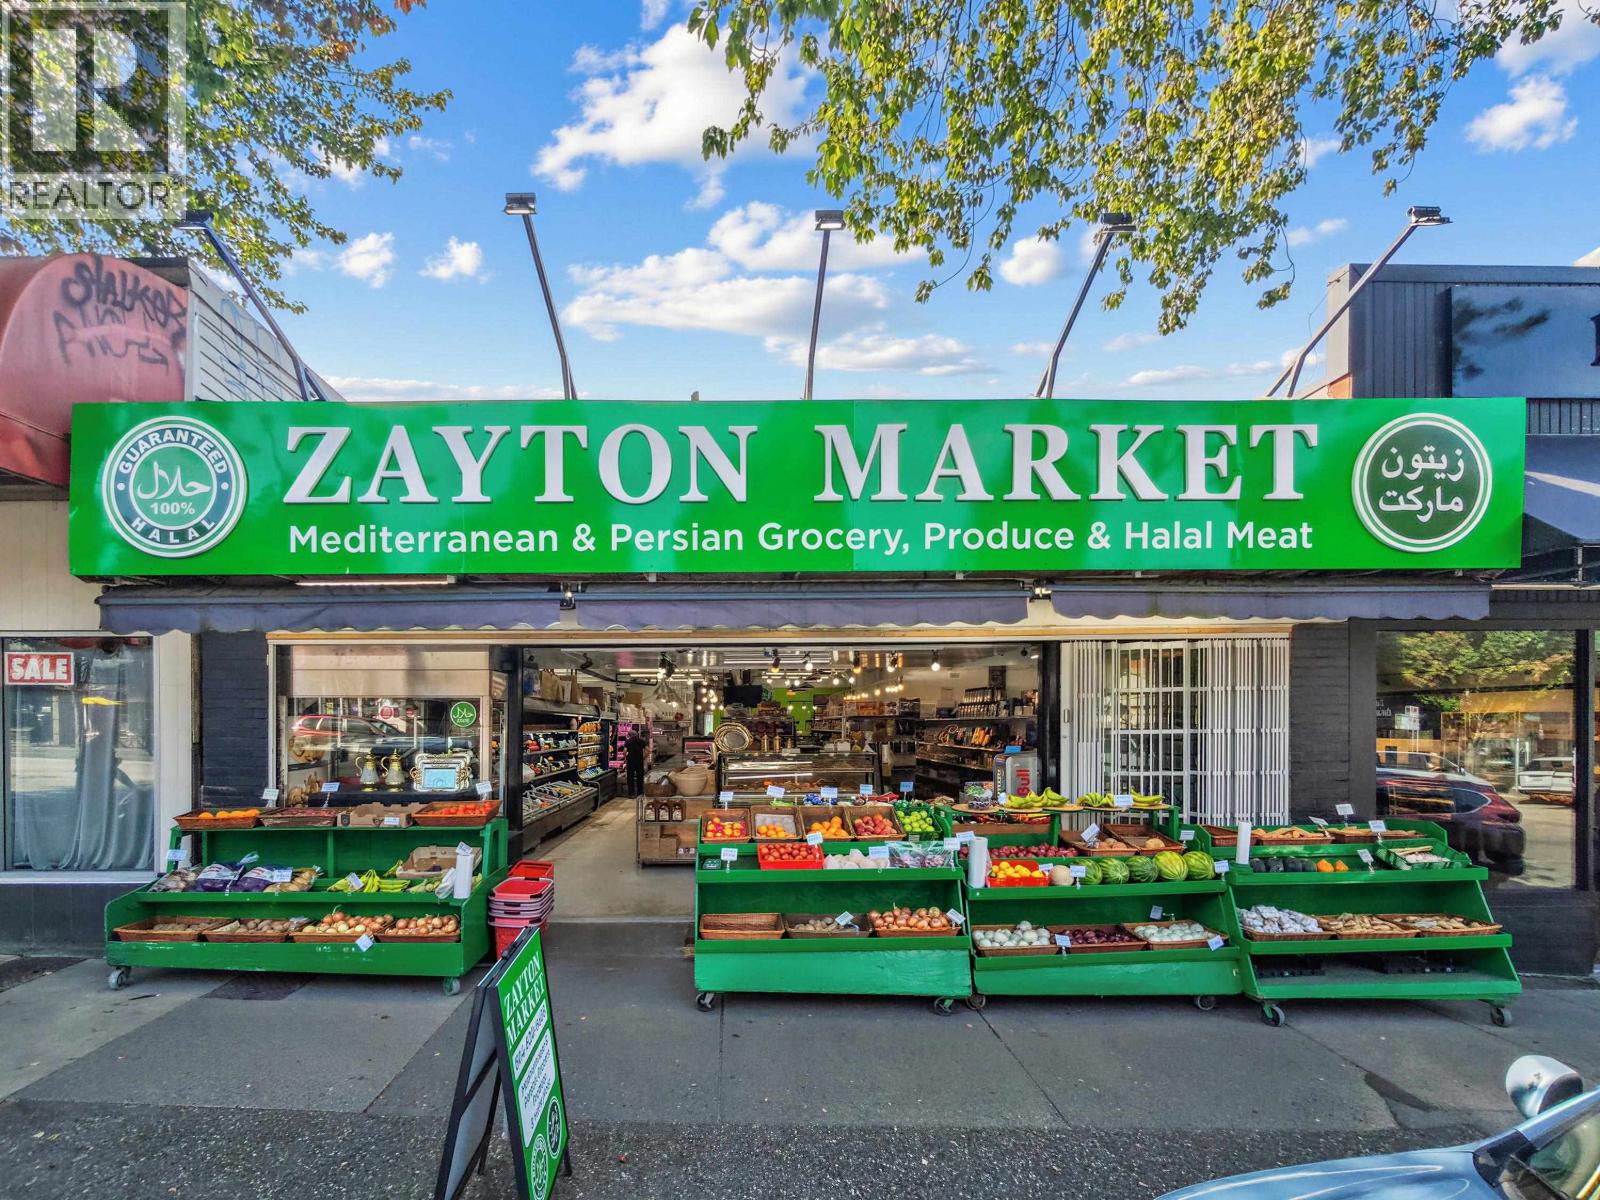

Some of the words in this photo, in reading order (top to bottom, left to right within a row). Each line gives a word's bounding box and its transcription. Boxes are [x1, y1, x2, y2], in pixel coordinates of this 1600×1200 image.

[118, 428, 229, 475] GUARANTEED
[283, 423, 758, 504] ZAYTON
[813, 423, 1319, 502] MARKET
[1381, 444, 1466, 482] زيتون
[136, 460, 212, 500] حلال
[149, 501, 196, 515] 100%
[1378, 485, 1465, 523] ماركت
[130, 516, 216, 544] HALAL
[289, 524, 558, 554] Mediterranean
[572, 523, 596, 552] &
[611, 522, 743, 552] Persian
[758, 522, 909, 557] Grocery,
[923, 521, 1074, 550] Produce
[1086, 521, 1111, 550] &
[1125, 520, 1213, 550] Halal
[1226, 521, 1312, 550] Meat
[11, 657, 68, 680] SALE
[503, 950, 541, 1022] ZAYTON
[506, 971, 545, 1050] MARKET
